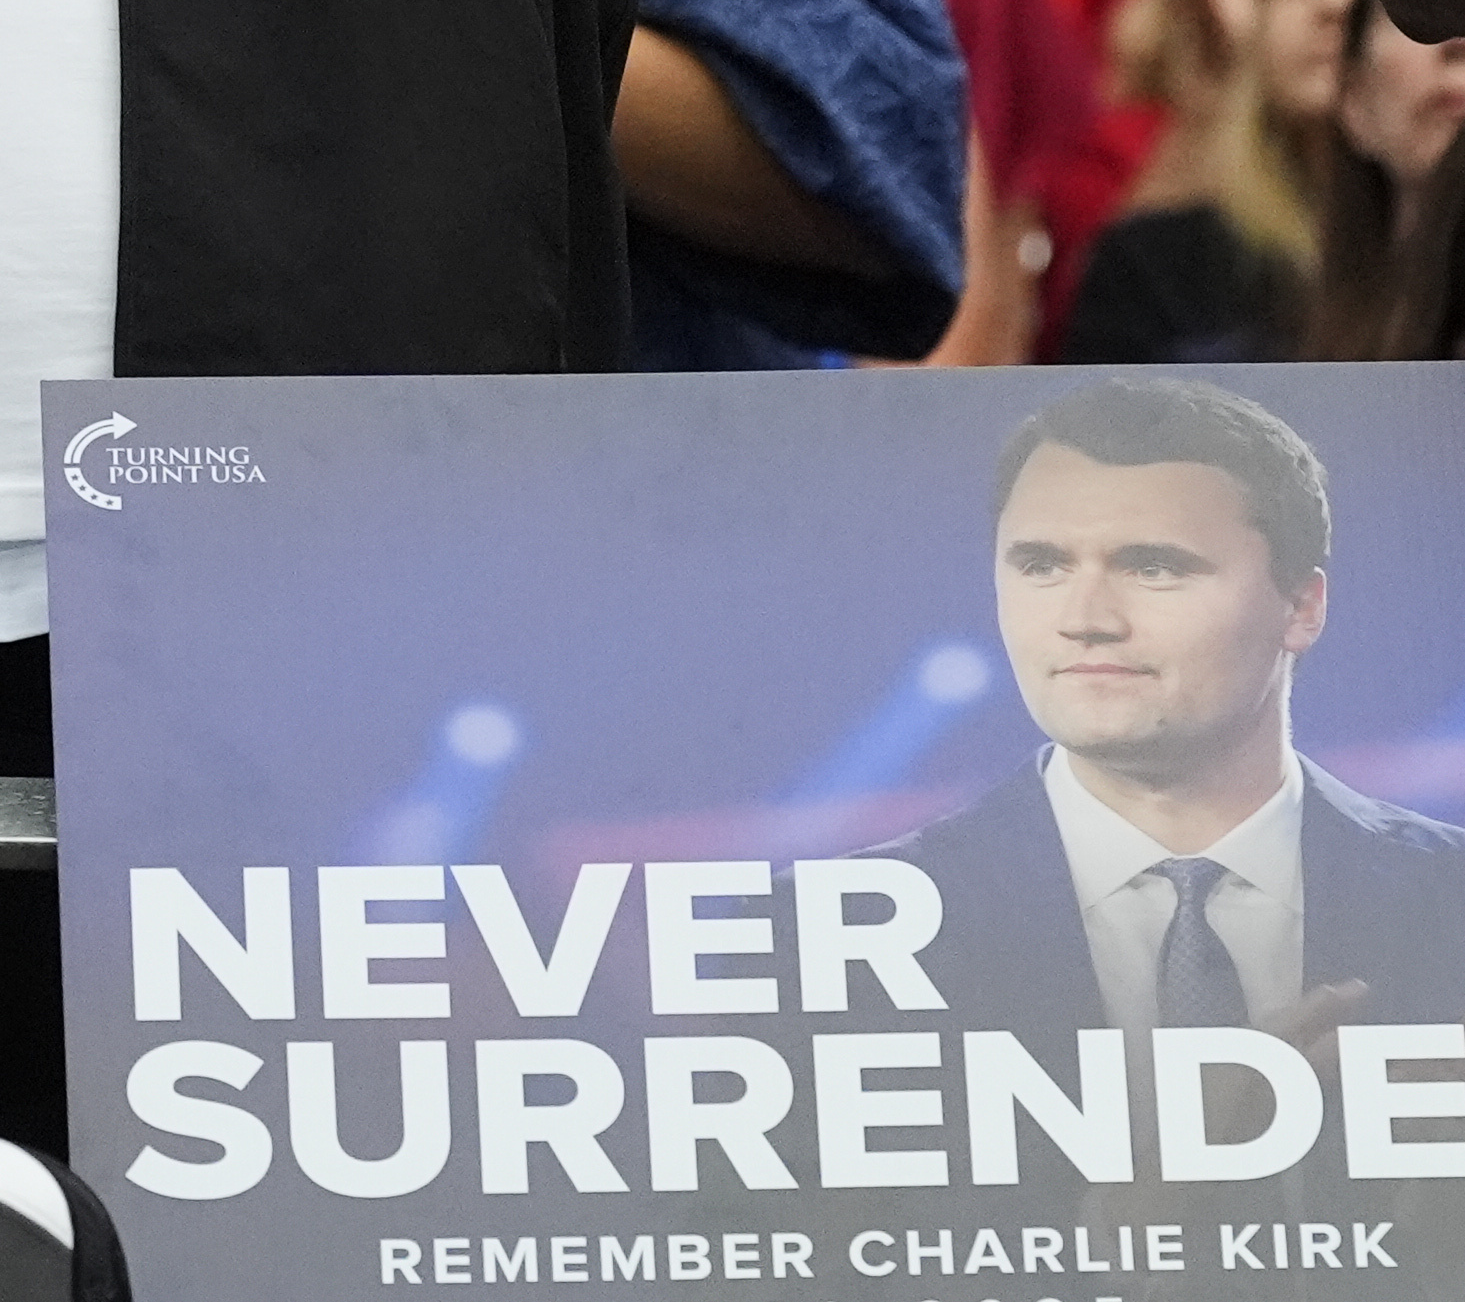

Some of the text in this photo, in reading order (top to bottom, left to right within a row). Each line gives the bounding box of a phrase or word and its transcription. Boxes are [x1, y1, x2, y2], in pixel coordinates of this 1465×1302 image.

[105, 446, 250, 467] TURNING
[109, 464, 267, 484] POINT USA
[129, 857, 950, 1023] NEVER
[379, 1221, 1399, 1286] REMEMBER CHARLIE KIRK
